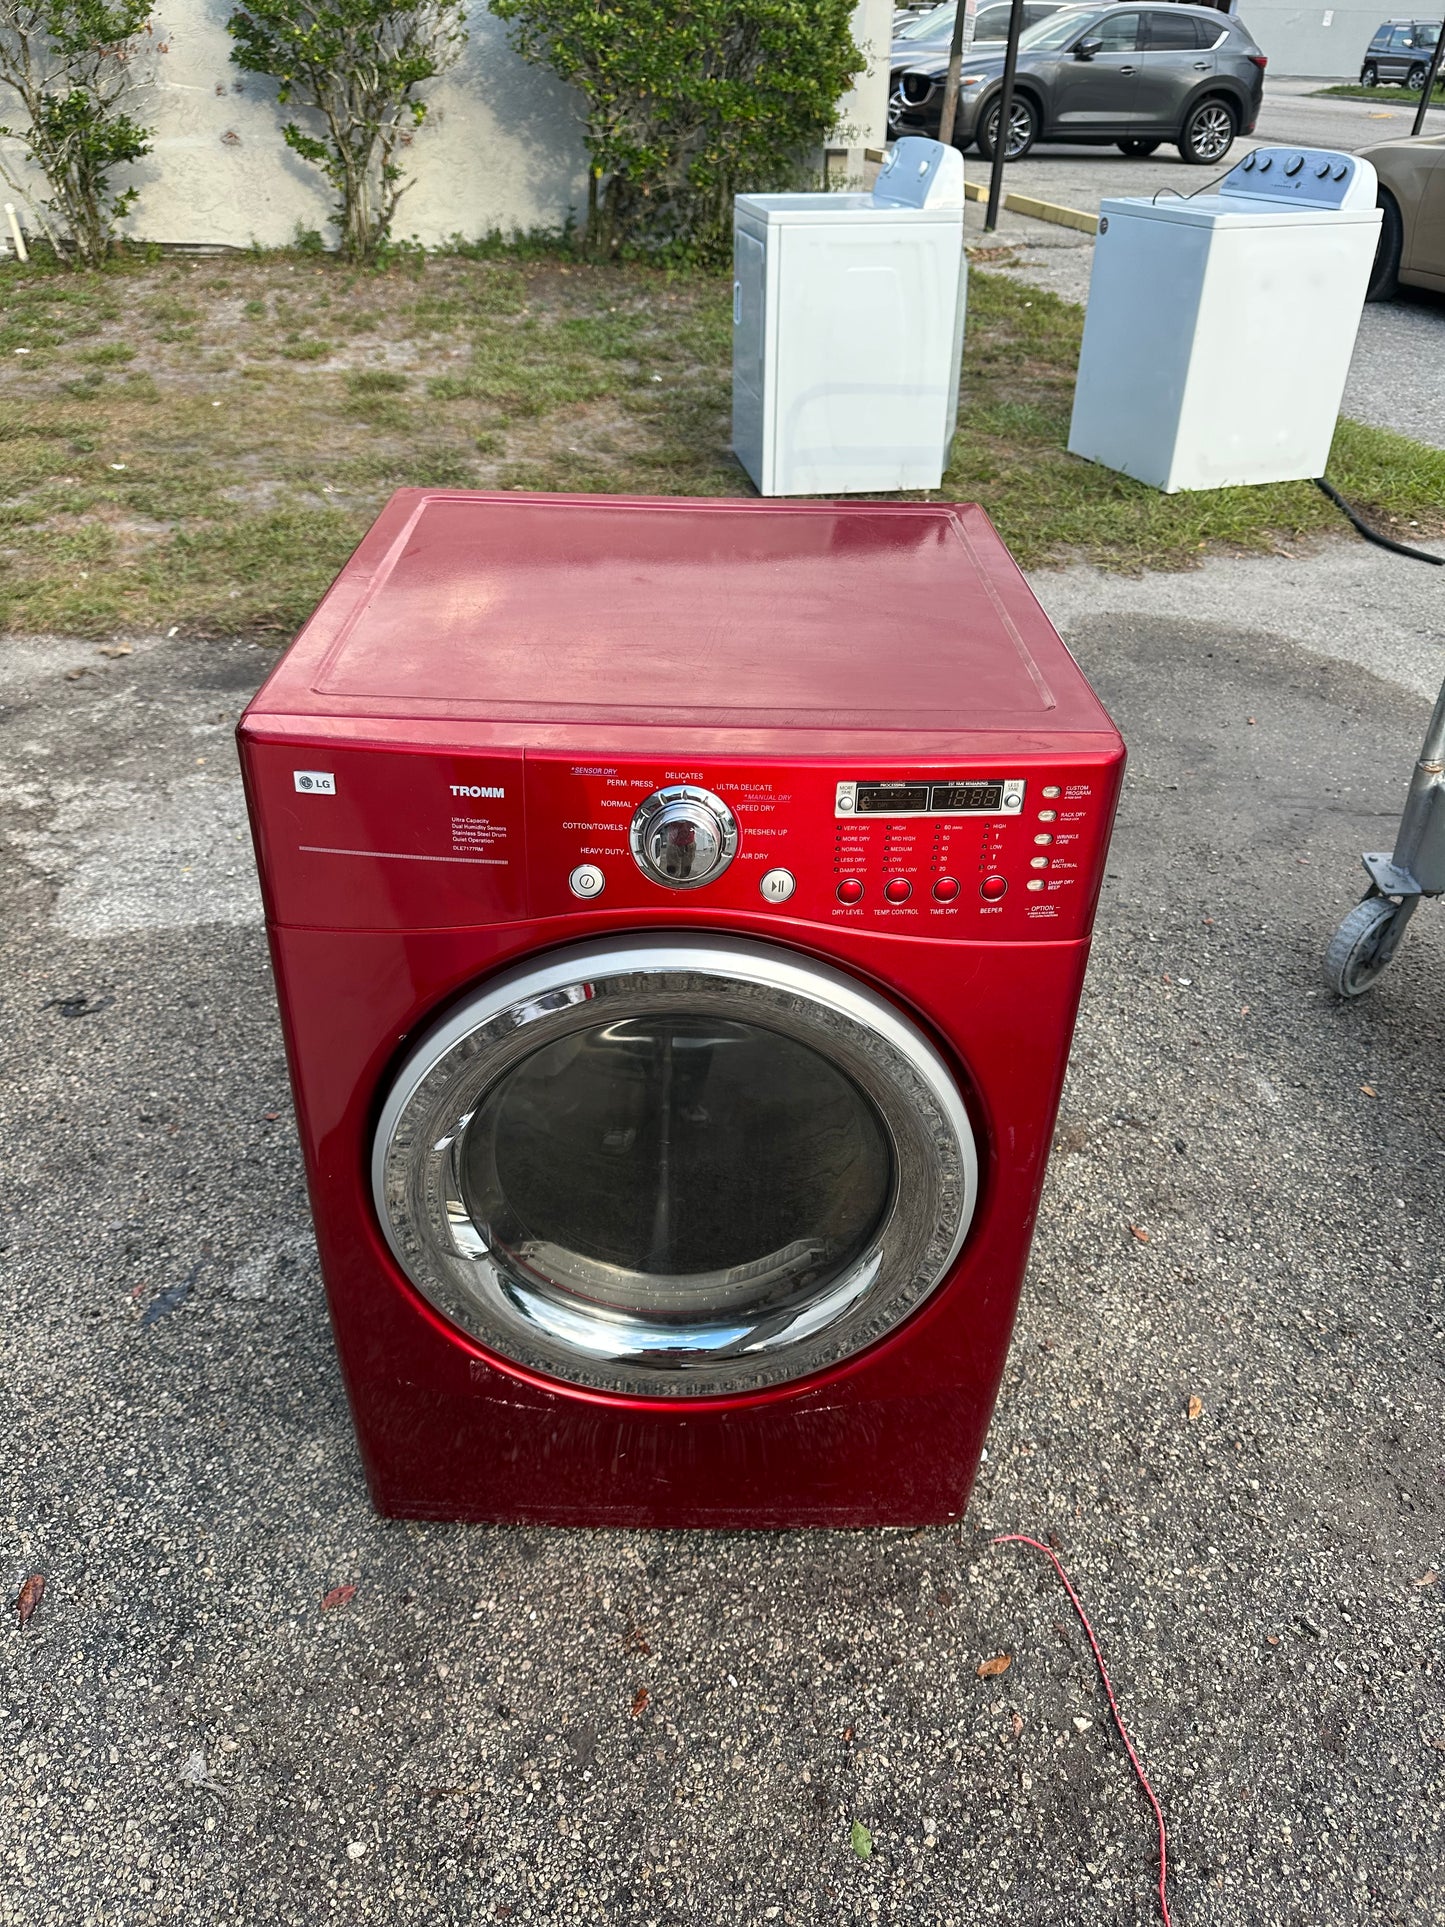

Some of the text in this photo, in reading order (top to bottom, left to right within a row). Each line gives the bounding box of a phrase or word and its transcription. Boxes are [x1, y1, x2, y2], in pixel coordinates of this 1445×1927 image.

[665, 772, 704, 780] DELICATES
[315, 780, 330, 788] LG
[630, 780, 654, 788] PRESS
[740, 784, 772, 792] DELICATE
[450, 785, 504, 798] TROMM
[562, 822, 623, 831] COTTON/TOWELS
